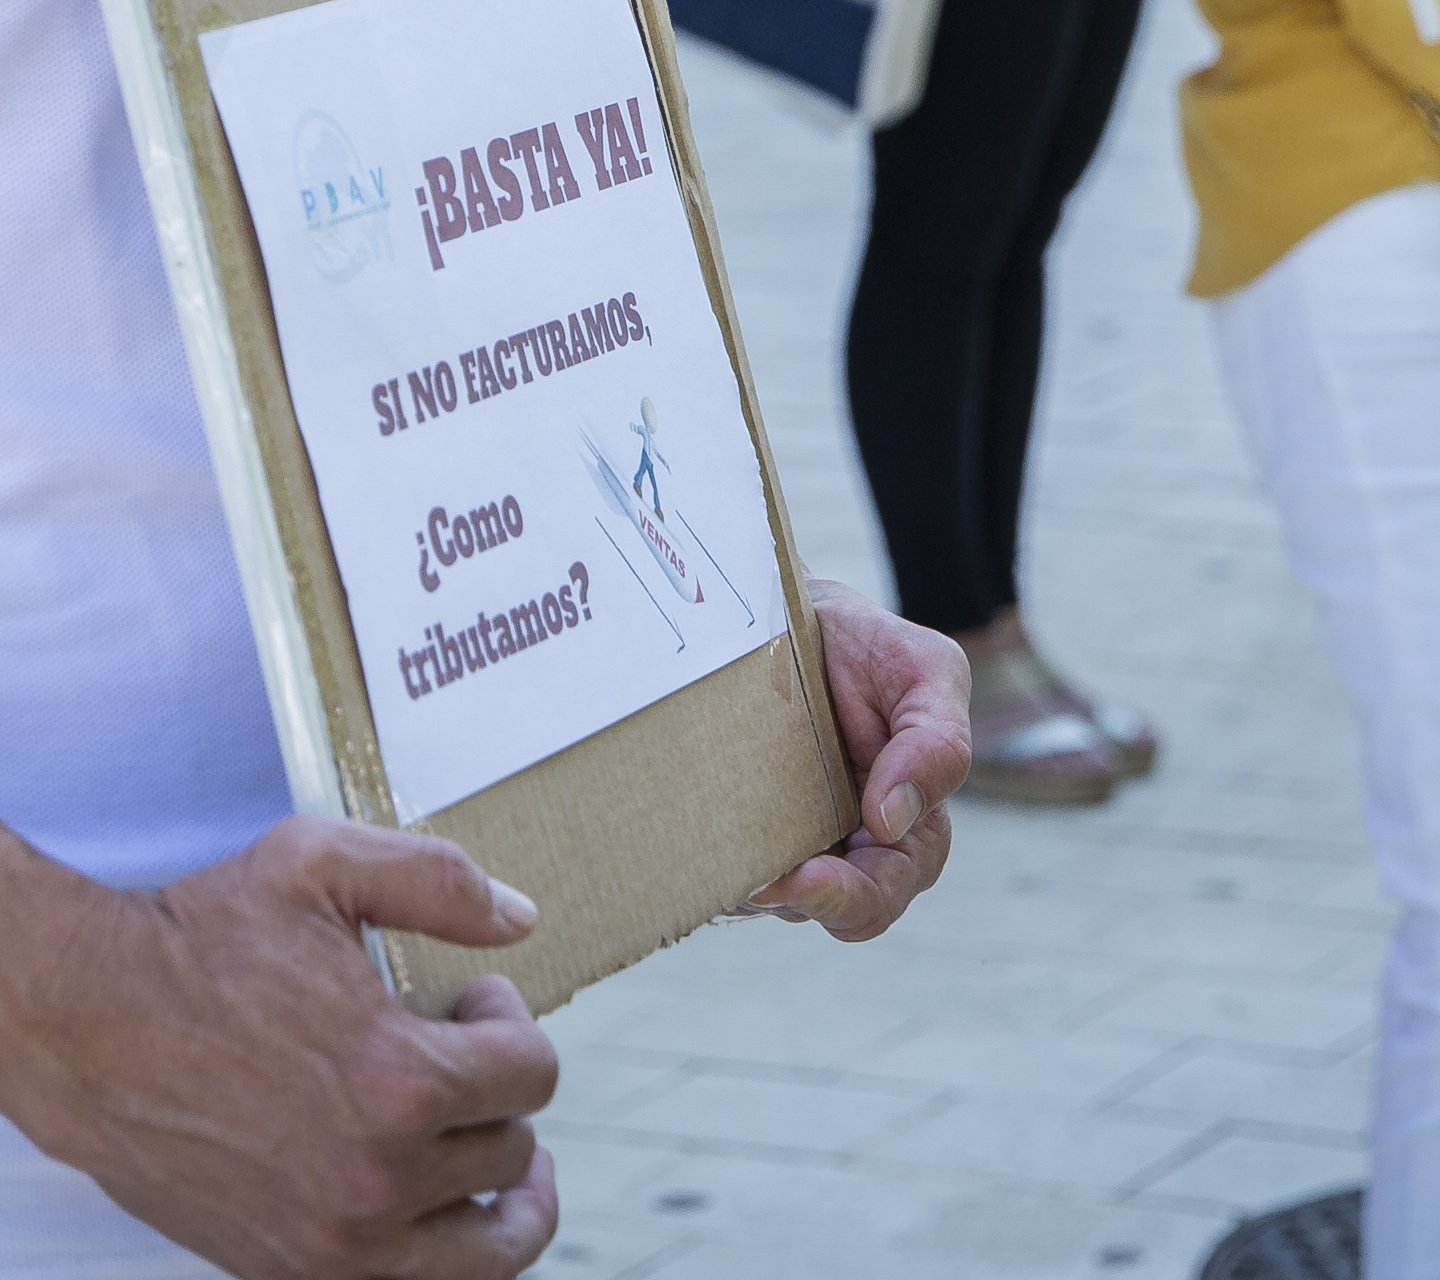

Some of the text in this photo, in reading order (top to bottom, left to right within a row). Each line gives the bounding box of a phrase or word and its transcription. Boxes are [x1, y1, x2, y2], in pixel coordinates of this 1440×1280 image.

[416, 96, 654, 270] ¡BASTA YA!
[372, 291, 653, 437] SI NO FACTURAMOS,
[416, 494, 523, 593] ¿Como
[638, 510, 687, 580] VENTAS
[398, 561, 592, 700] tributamos?
